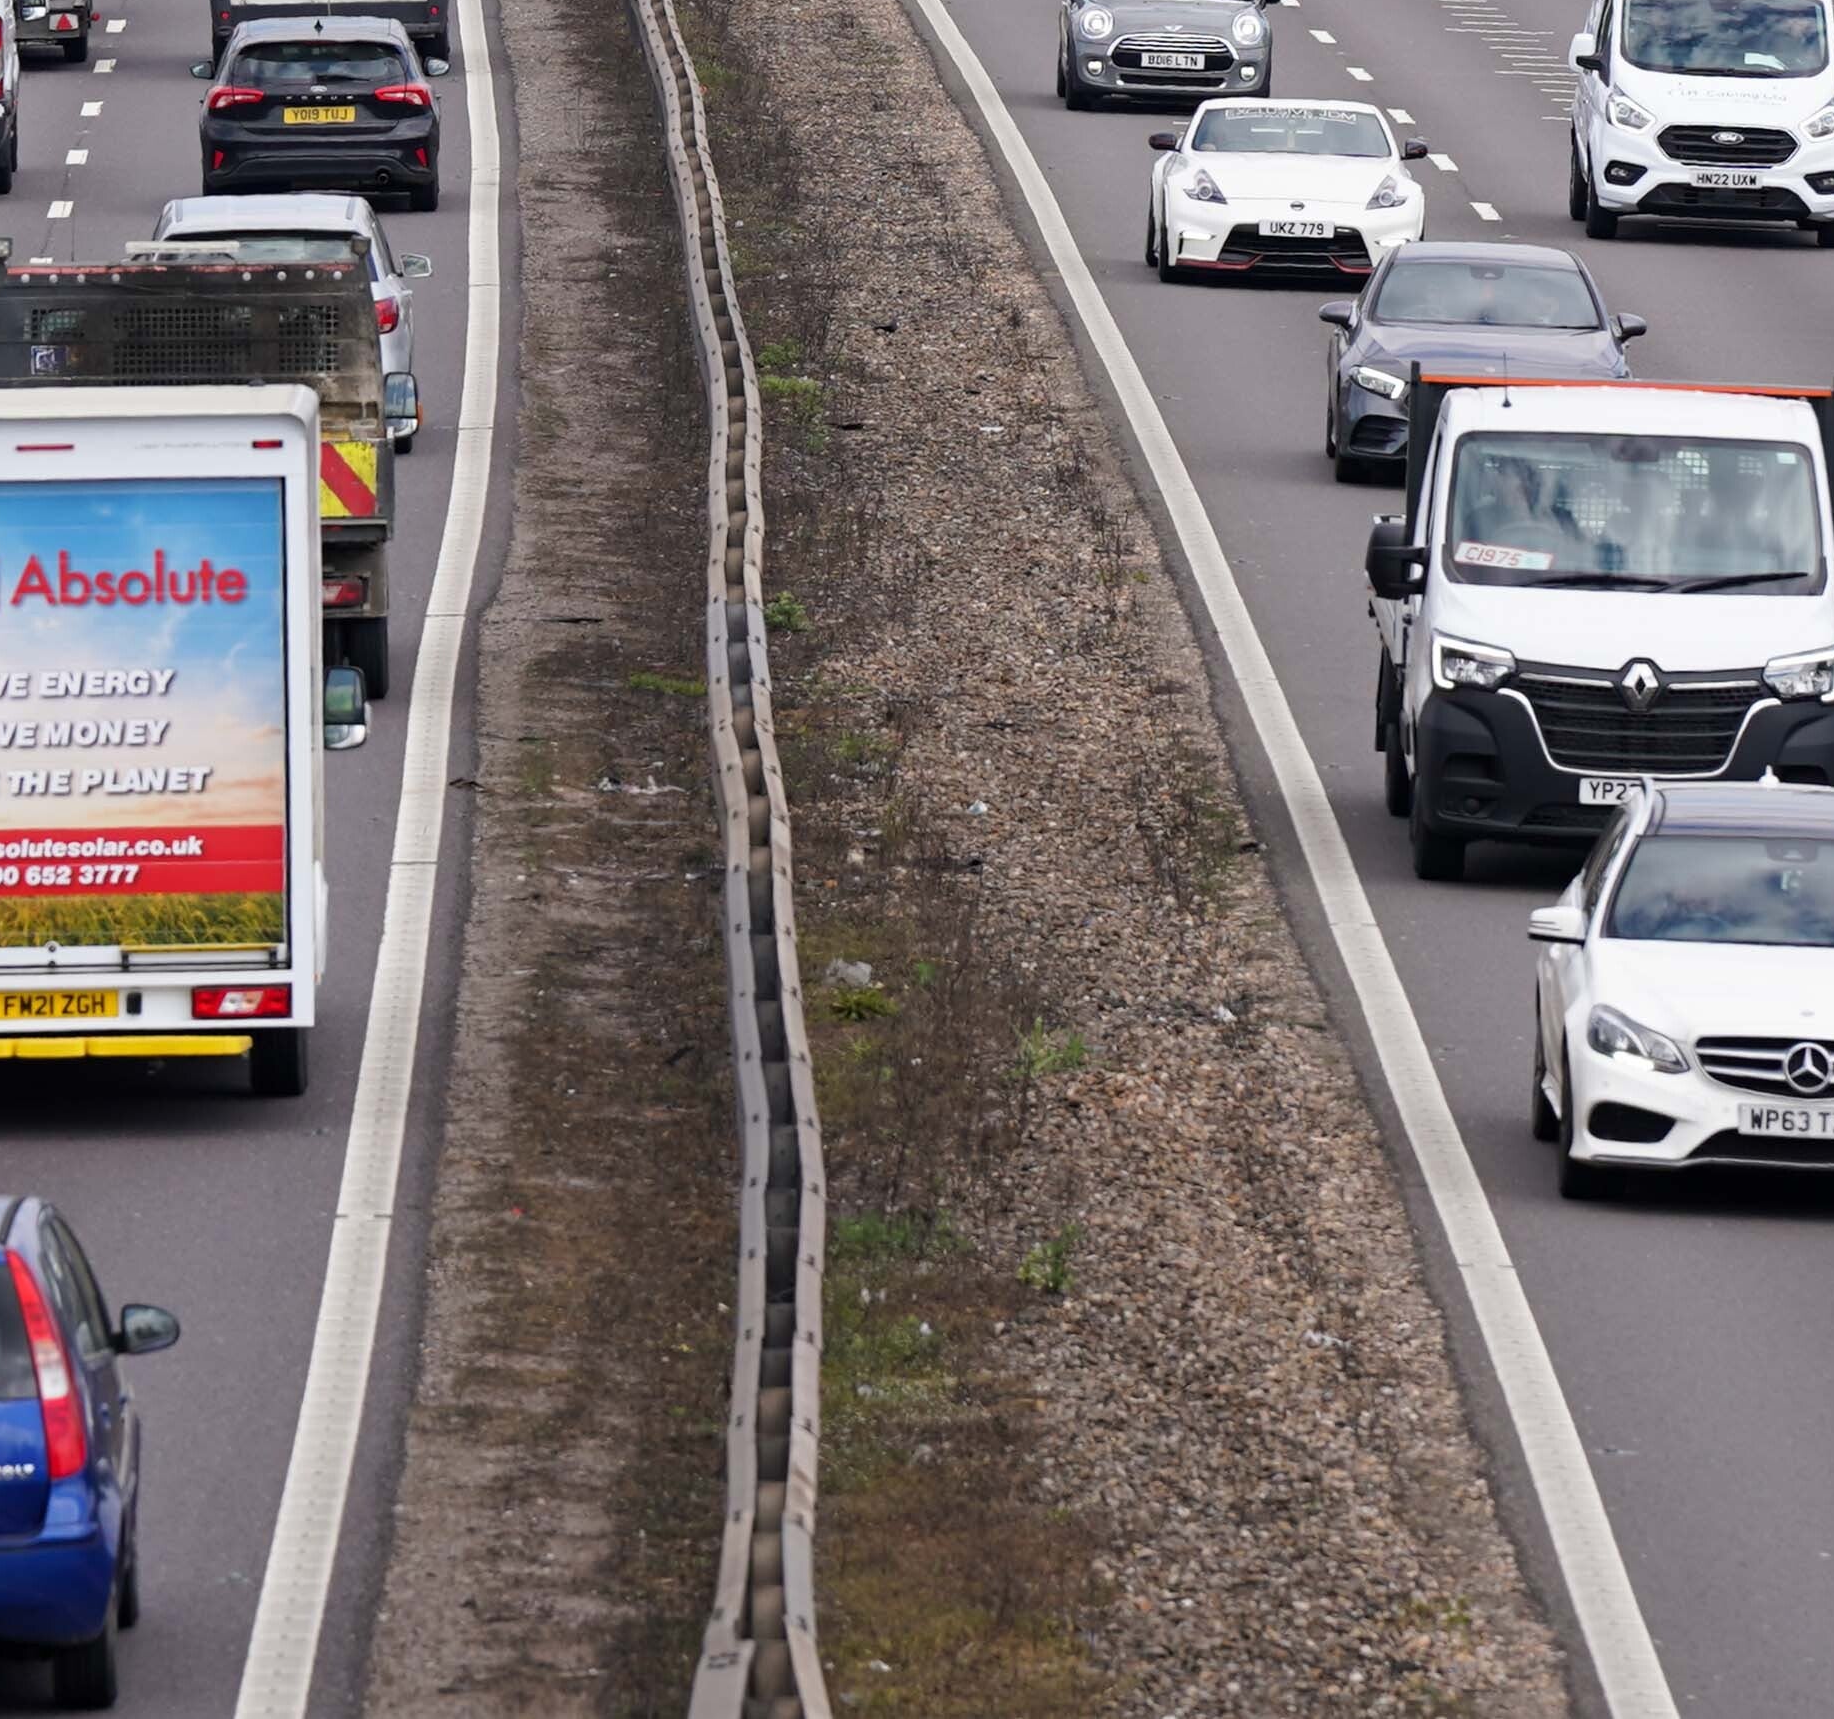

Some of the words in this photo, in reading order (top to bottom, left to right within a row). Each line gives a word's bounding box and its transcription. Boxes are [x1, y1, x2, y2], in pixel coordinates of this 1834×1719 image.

[1176, 56, 1198, 66] LTN
[324, 109, 348, 121] TUJ
[1696, 174, 1728, 186] HN22
[1732, 174, 1757, 186] UXW
[1270, 223, 1295, 235] UKZ
[1301, 223, 1324, 235] 779
[11, 549, 247, 606] Absolute
[39, 669, 176, 699] ENERGY
[42, 720, 171, 748] MONEY
[8, 768, 72, 796] THE
[79, 766, 211, 795] PLANET
[25, 866, 71, 886] 652
[78, 864, 139, 885] 3777
[4, 995, 54, 1017] FM21
[62, 994, 105, 1016] ZGH
[1750, 1108, 1811, 1130] WP63
